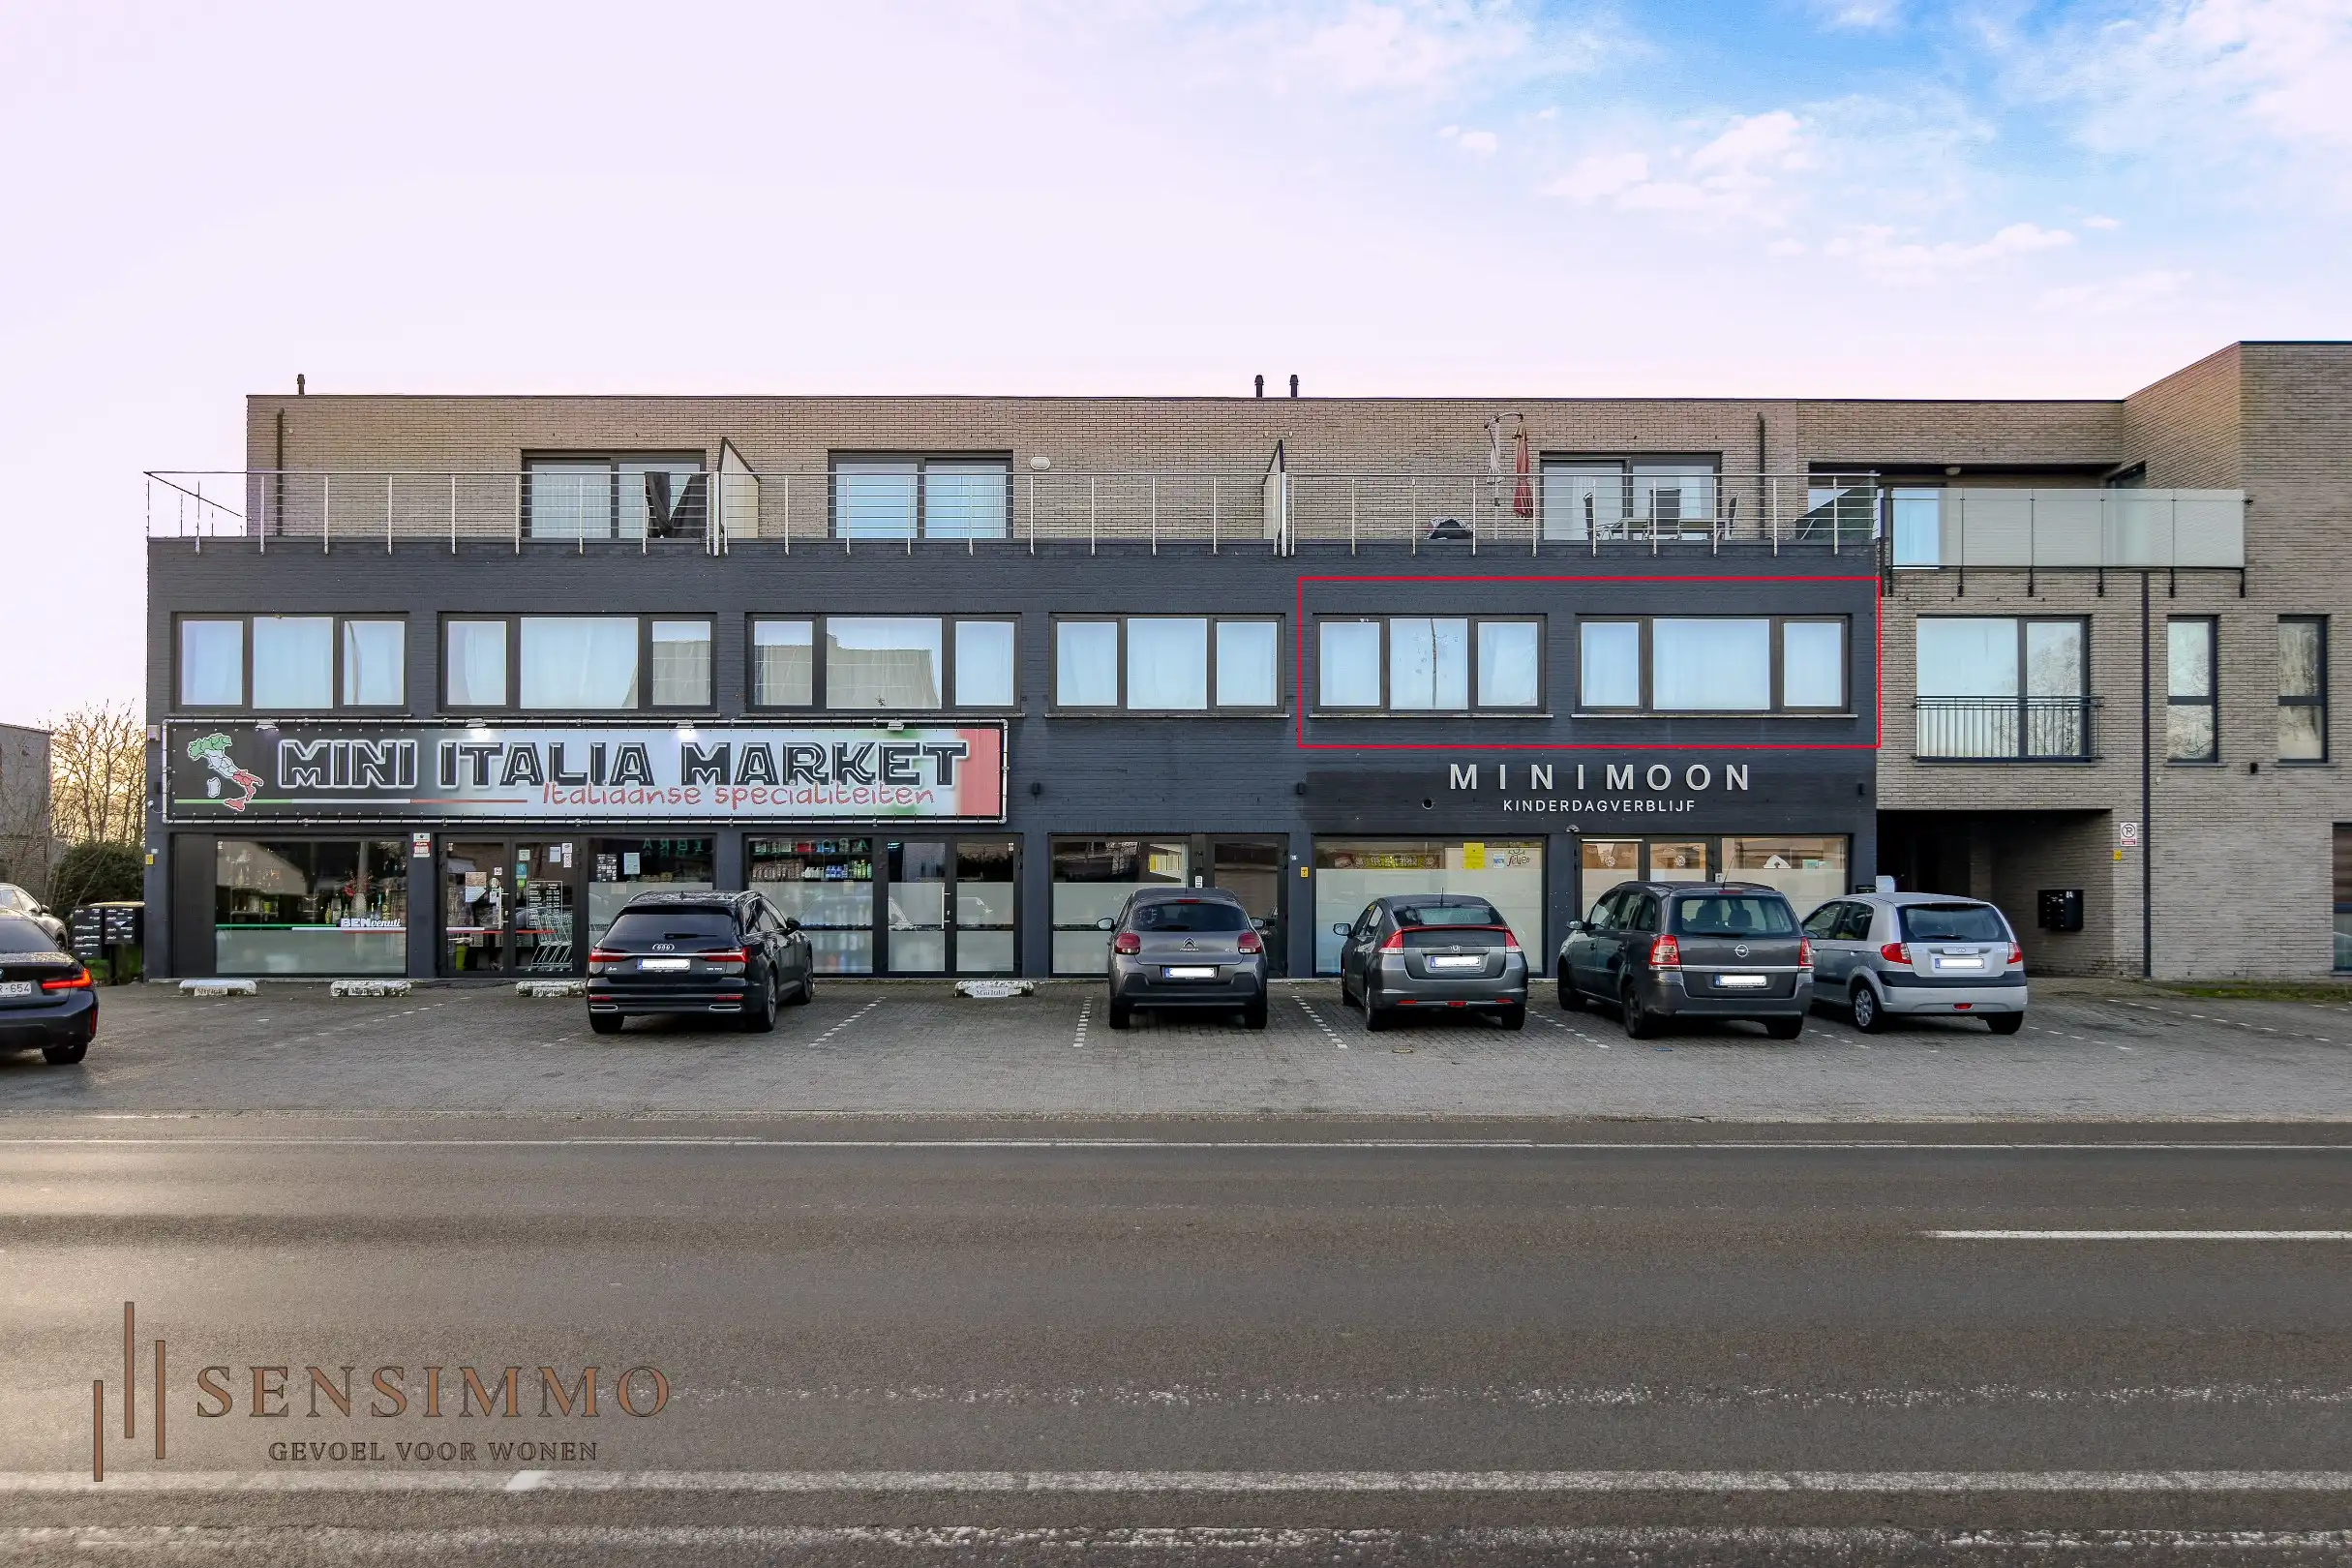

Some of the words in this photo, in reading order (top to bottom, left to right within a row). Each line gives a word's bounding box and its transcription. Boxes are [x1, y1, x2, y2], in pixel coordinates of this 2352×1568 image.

[280, 740, 416, 788] MINI
[440, 740, 655, 788] ITALIA
[680, 740, 967, 787] MARKET
[1450, 763, 1748, 791] MINIMOON
[542, 781, 702, 805] Italiaanse
[714, 780, 935, 810] specialiteiten
[1503, 799, 1695, 812] KINDERDAGVERBLIJF
